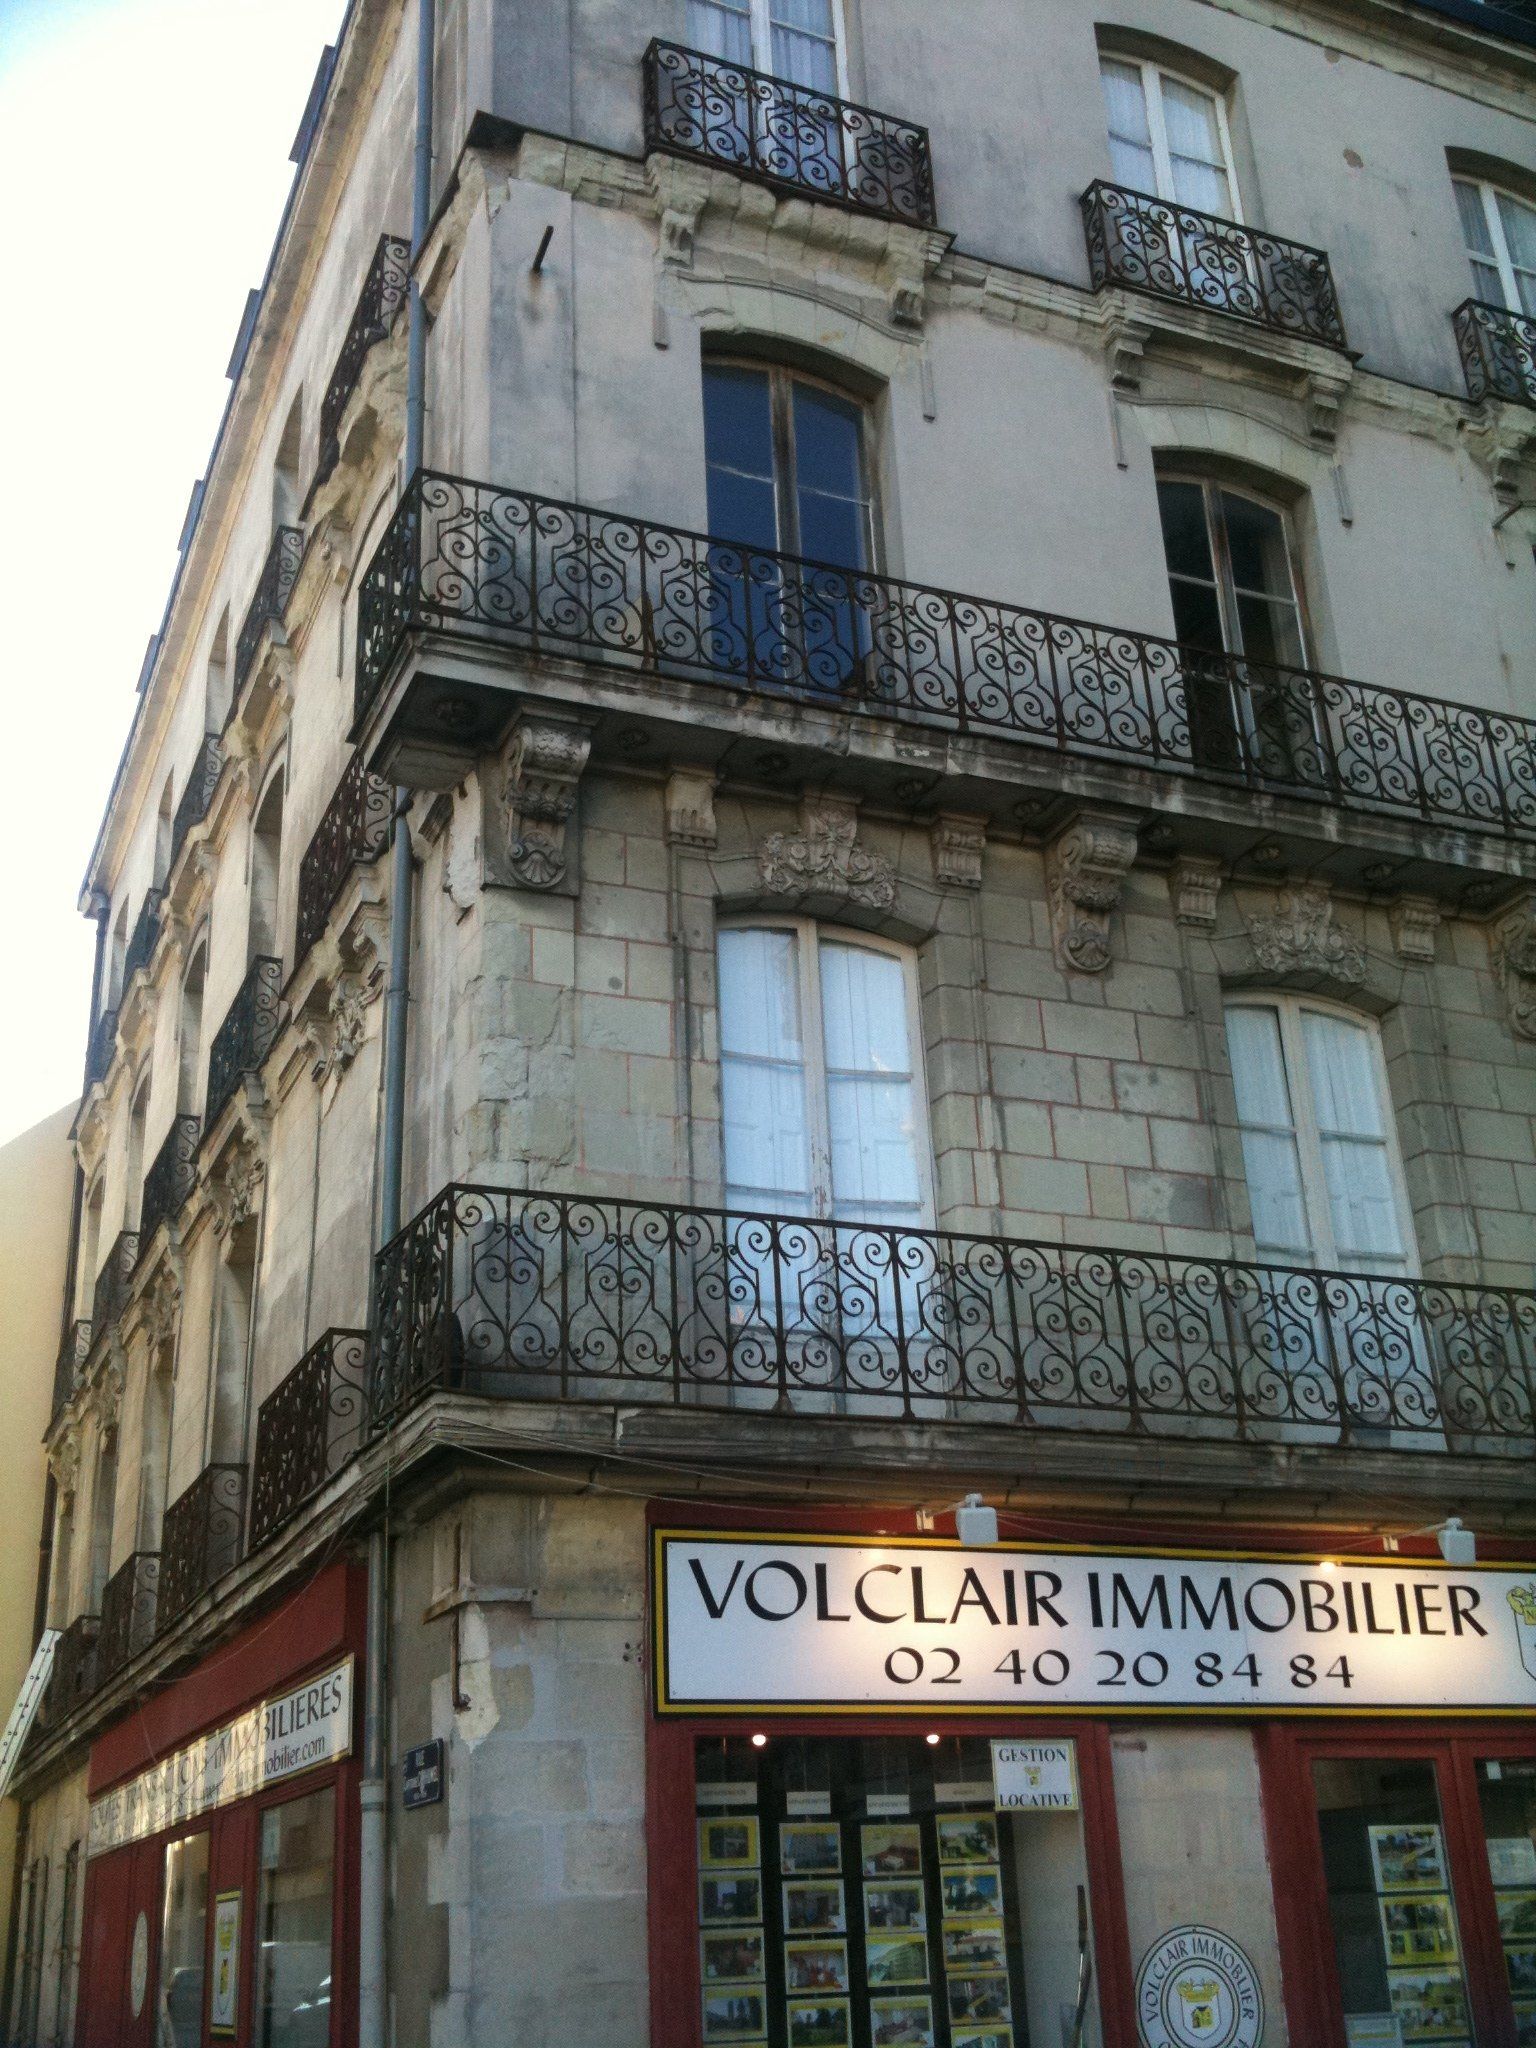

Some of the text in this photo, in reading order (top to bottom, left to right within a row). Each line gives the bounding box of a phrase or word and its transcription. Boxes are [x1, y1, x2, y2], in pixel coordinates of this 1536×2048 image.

[688, 1558, 1488, 1637] VOLCLAIR IMMOBILIER
[884, 1646, 1354, 1688] 02 40 20 84 84
[999, 1748, 1067, 1762] GESTION
[1000, 1793, 1072, 1807] LOCATIVE
[1145, 1940, 1189, 2023] VOLCLAIR
